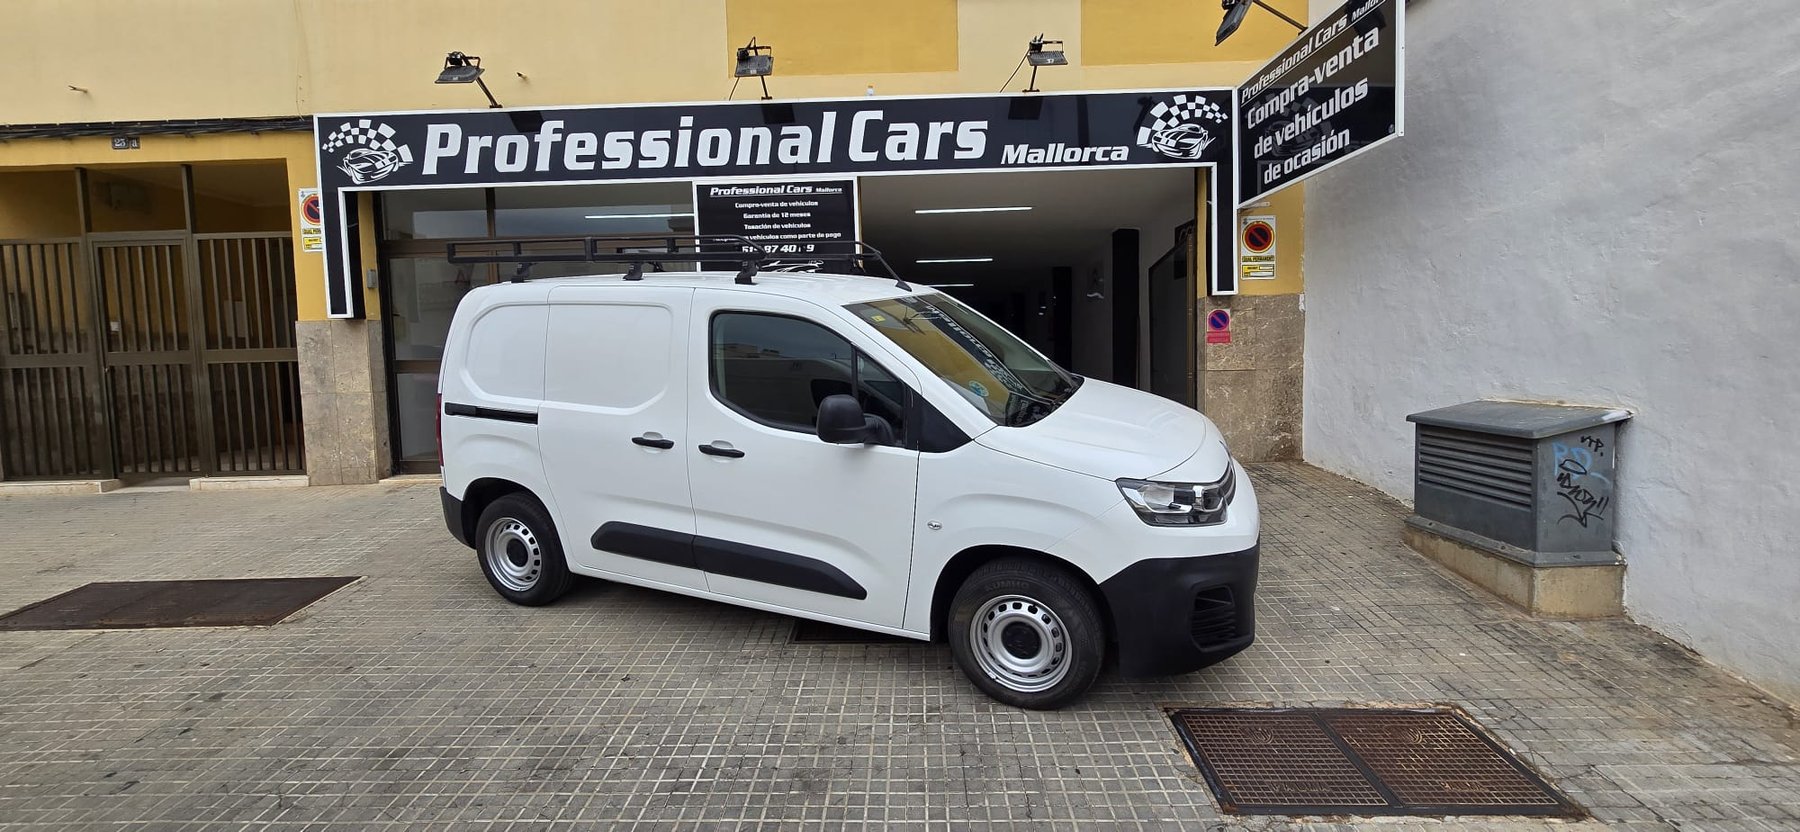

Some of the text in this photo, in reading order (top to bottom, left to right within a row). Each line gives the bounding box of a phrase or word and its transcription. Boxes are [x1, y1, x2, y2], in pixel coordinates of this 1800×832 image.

[1241, 37, 1313, 103] Professional
[1314, 14, 1348, 48] Cars
[1247, 27, 1379, 129] Compra-venta
[422, 110, 1129, 175] Professional Cars Mallorca
[1254, 77, 1368, 159] de vehículos
[1264, 129, 1350, 184] de ocasión
[710, 185, 784, 196] Professional
[786, 185, 813, 194] Cars
[780, 244, 797, 253] 40
